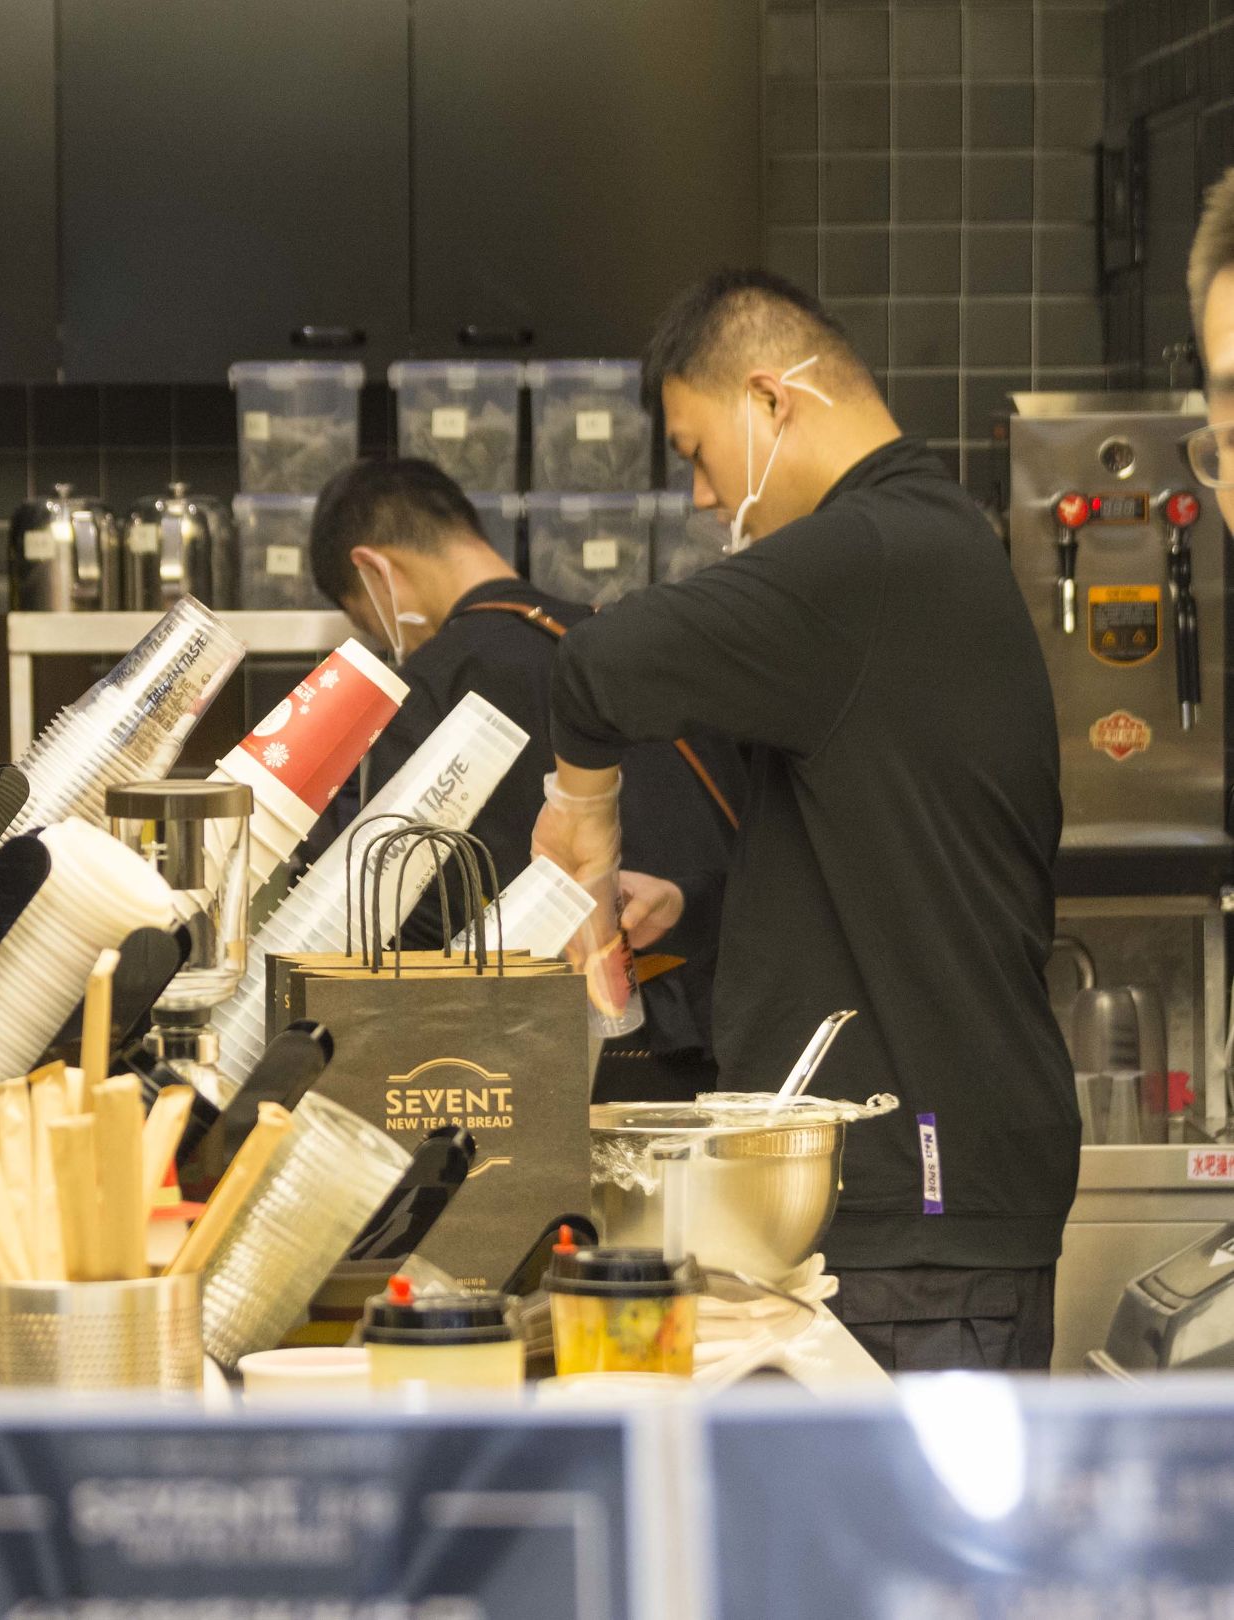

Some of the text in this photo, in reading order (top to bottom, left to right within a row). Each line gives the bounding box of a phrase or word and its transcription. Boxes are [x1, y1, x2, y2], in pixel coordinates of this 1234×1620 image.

[179, 633, 208, 669] TASTE
[419, 754, 470, 813] TASTE
[385, 1087, 513, 1115] SEVENT.
[386, 1115, 513, 1130] NEW TEA & BREAD
[927, 1163, 938, 1199] SPORT
